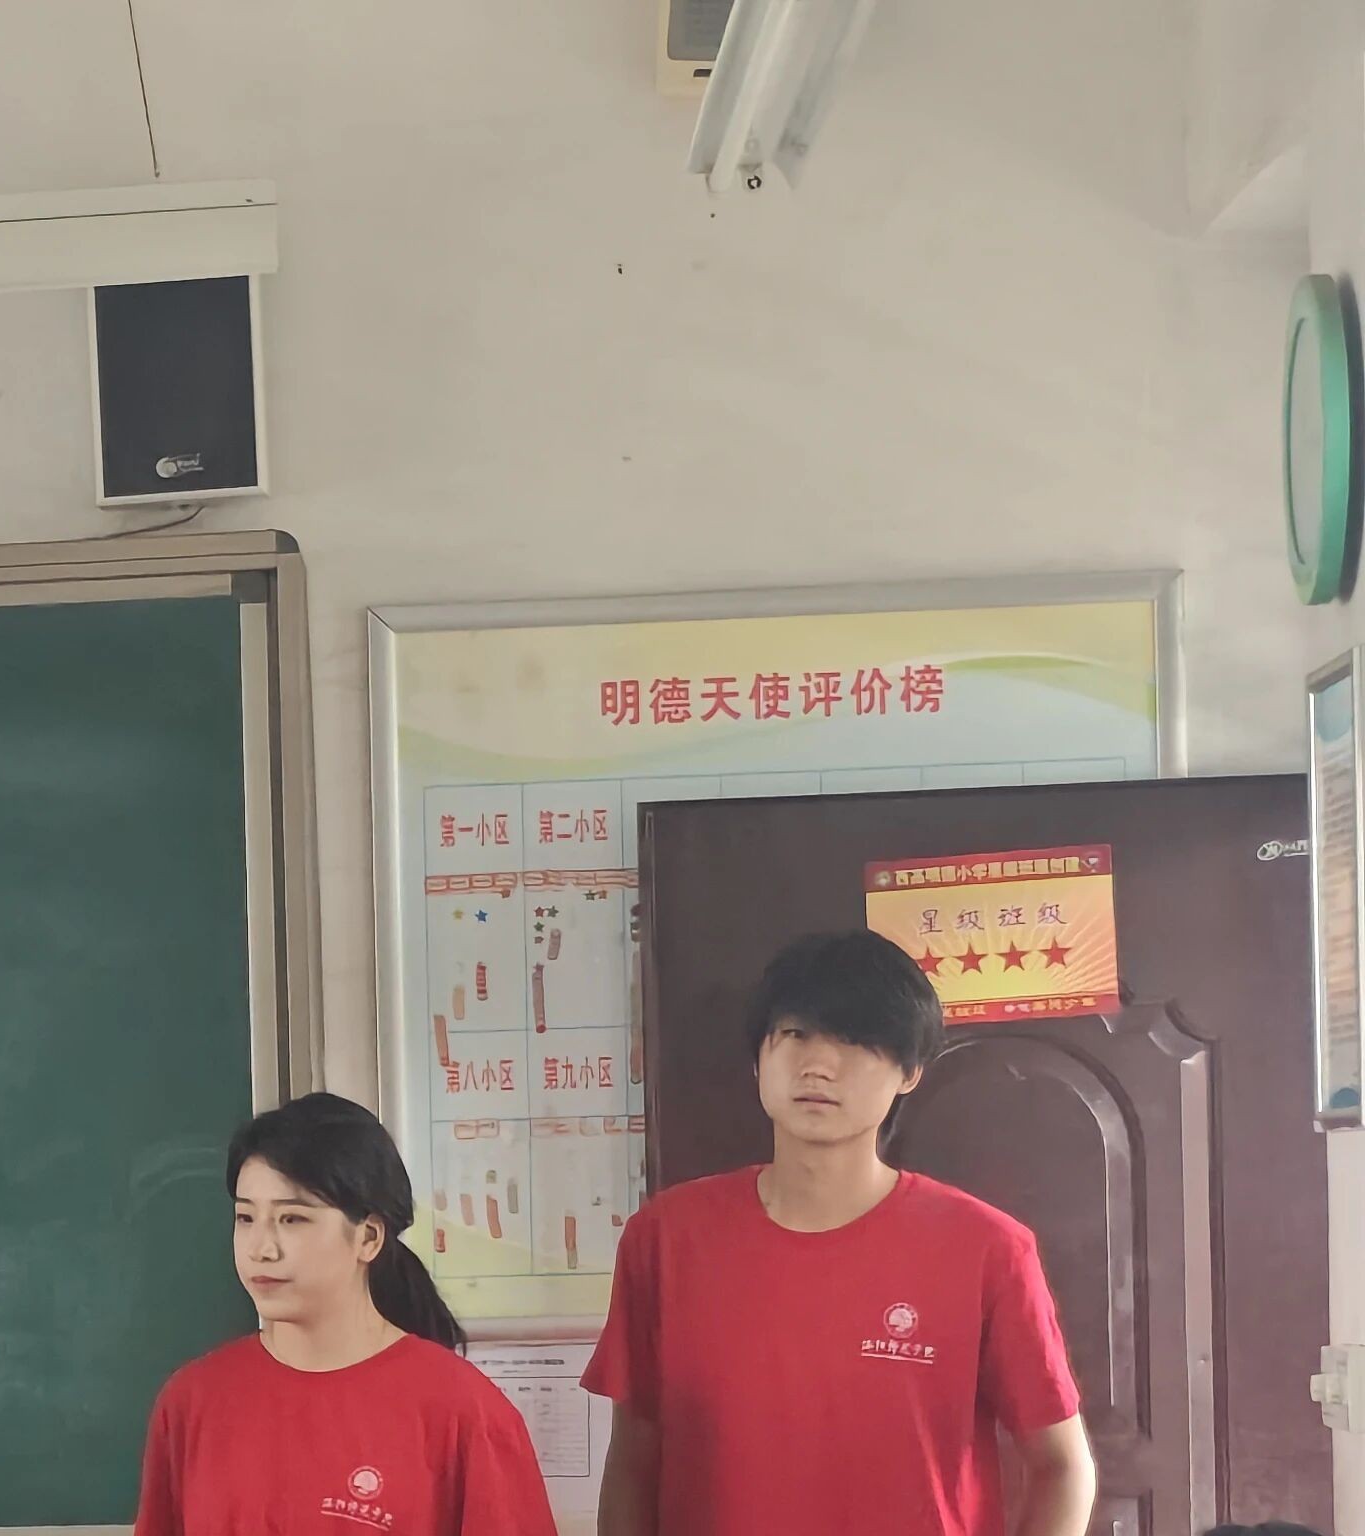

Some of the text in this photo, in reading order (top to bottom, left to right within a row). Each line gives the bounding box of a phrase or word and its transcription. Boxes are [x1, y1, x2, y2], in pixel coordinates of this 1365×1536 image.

[600, 664, 945, 726] 明德天使评价榜
[440, 812, 510, 847] 第一小区
[539, 809, 609, 844] 第二小区
[919, 902, 1068, 936] 星级班级
[445, 1058, 515, 1094] 第八小区
[544, 1056, 614, 1090] 第九小区
